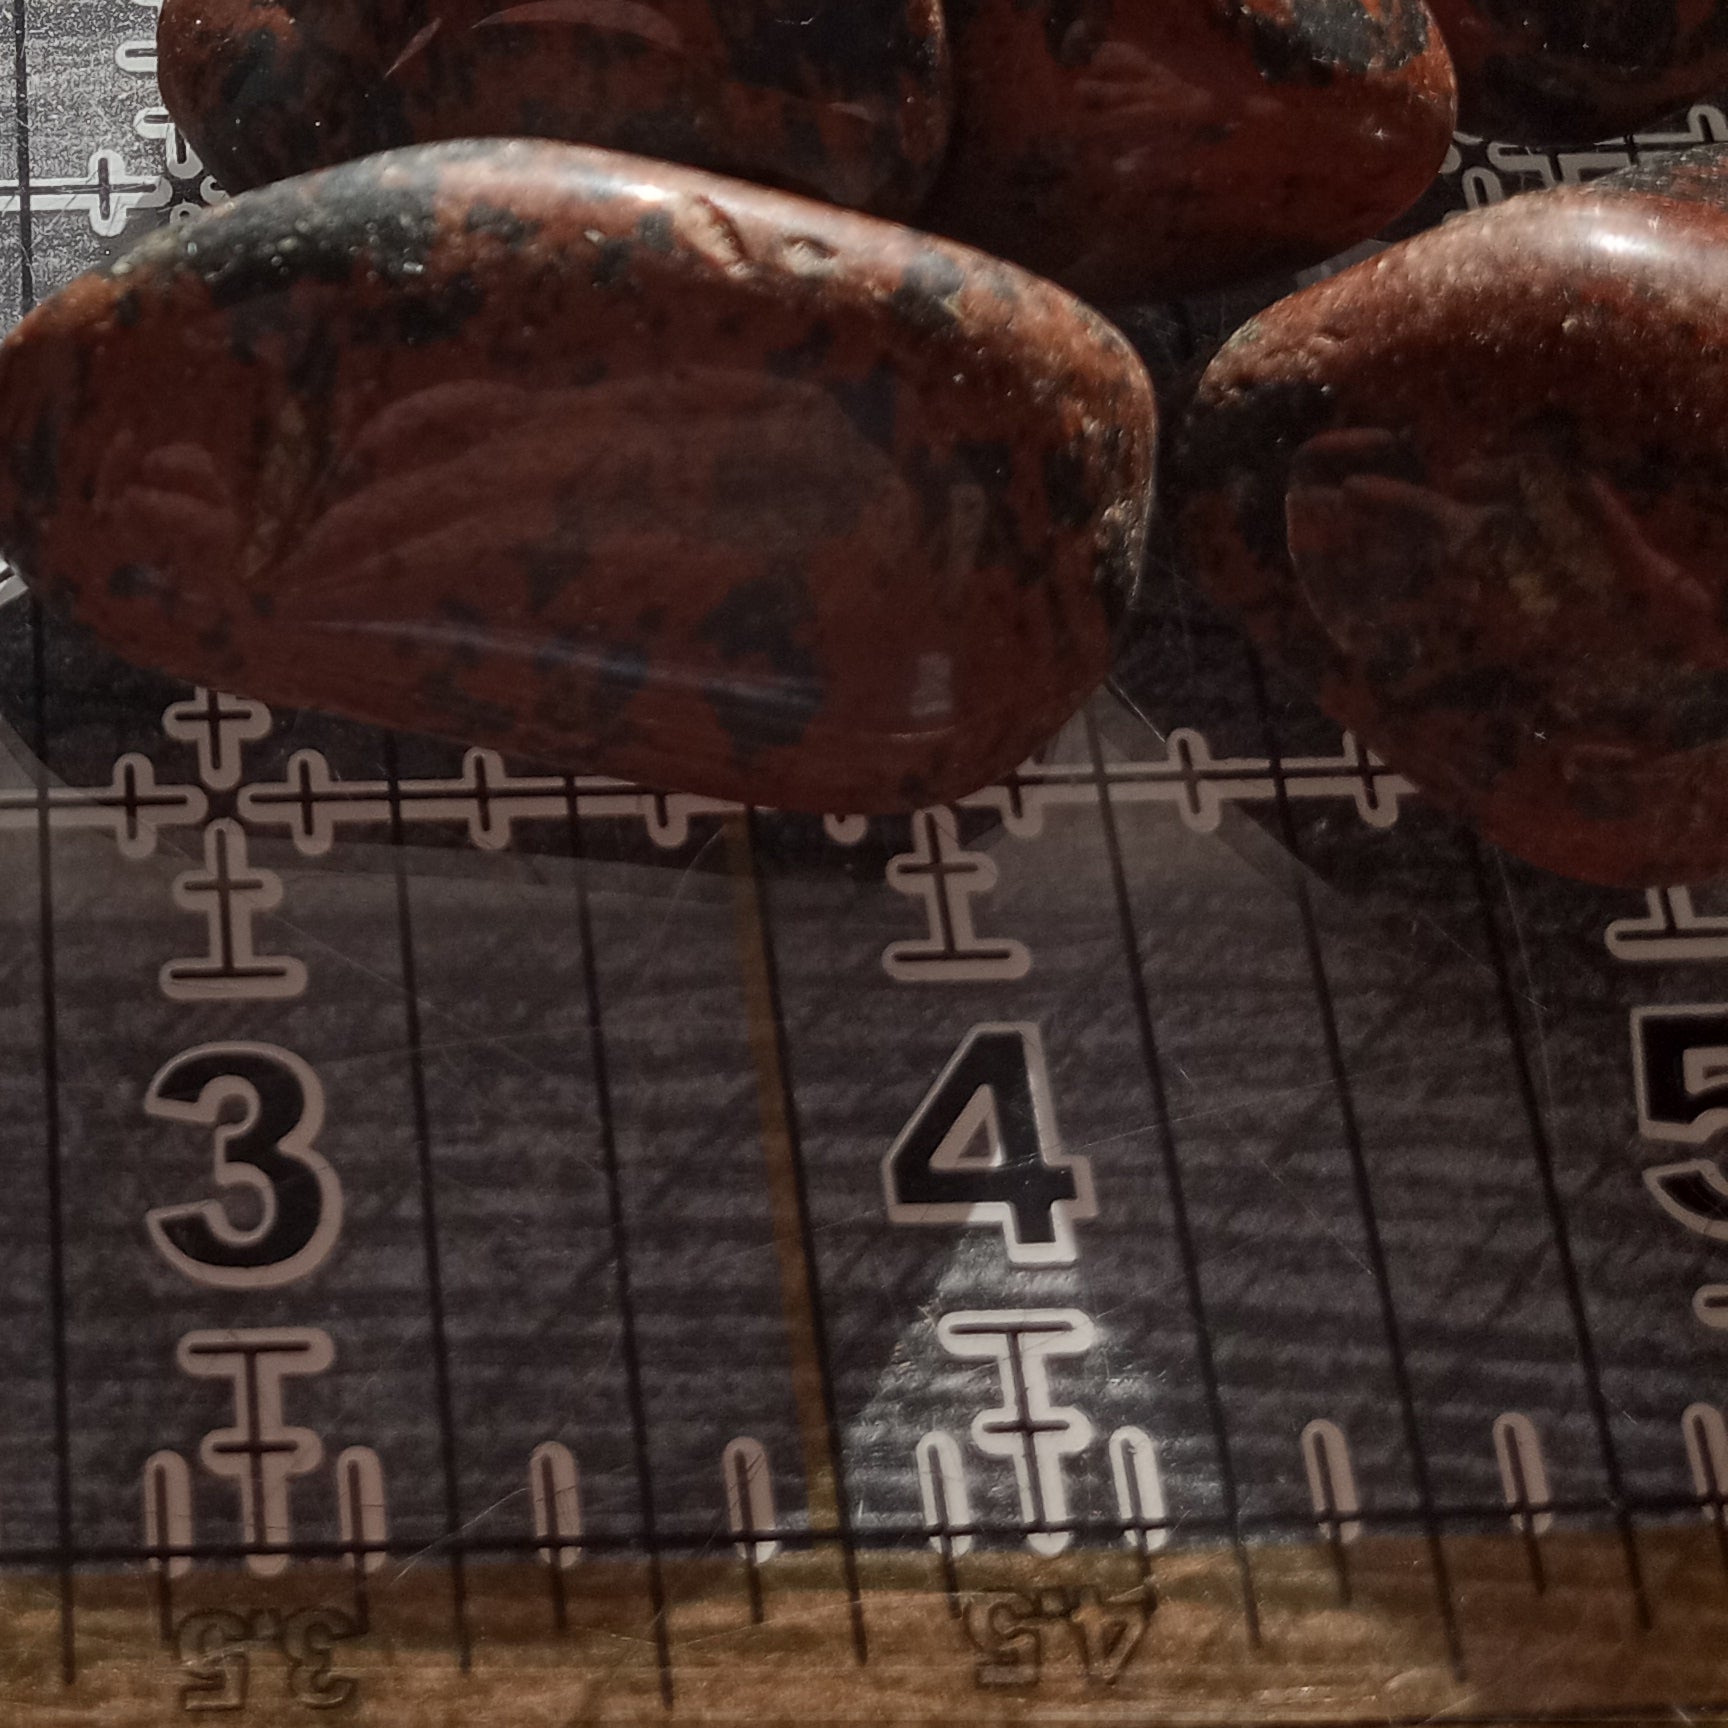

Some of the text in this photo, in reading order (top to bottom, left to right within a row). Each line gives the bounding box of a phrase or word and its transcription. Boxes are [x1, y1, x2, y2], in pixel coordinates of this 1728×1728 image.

[144, 1040, 343, 1288] 3
[881, 1020, 1099, 1265] 4
[176, 1606, 360, 1712] 3.5
[962, 1585, 1154, 1690] 4.5
